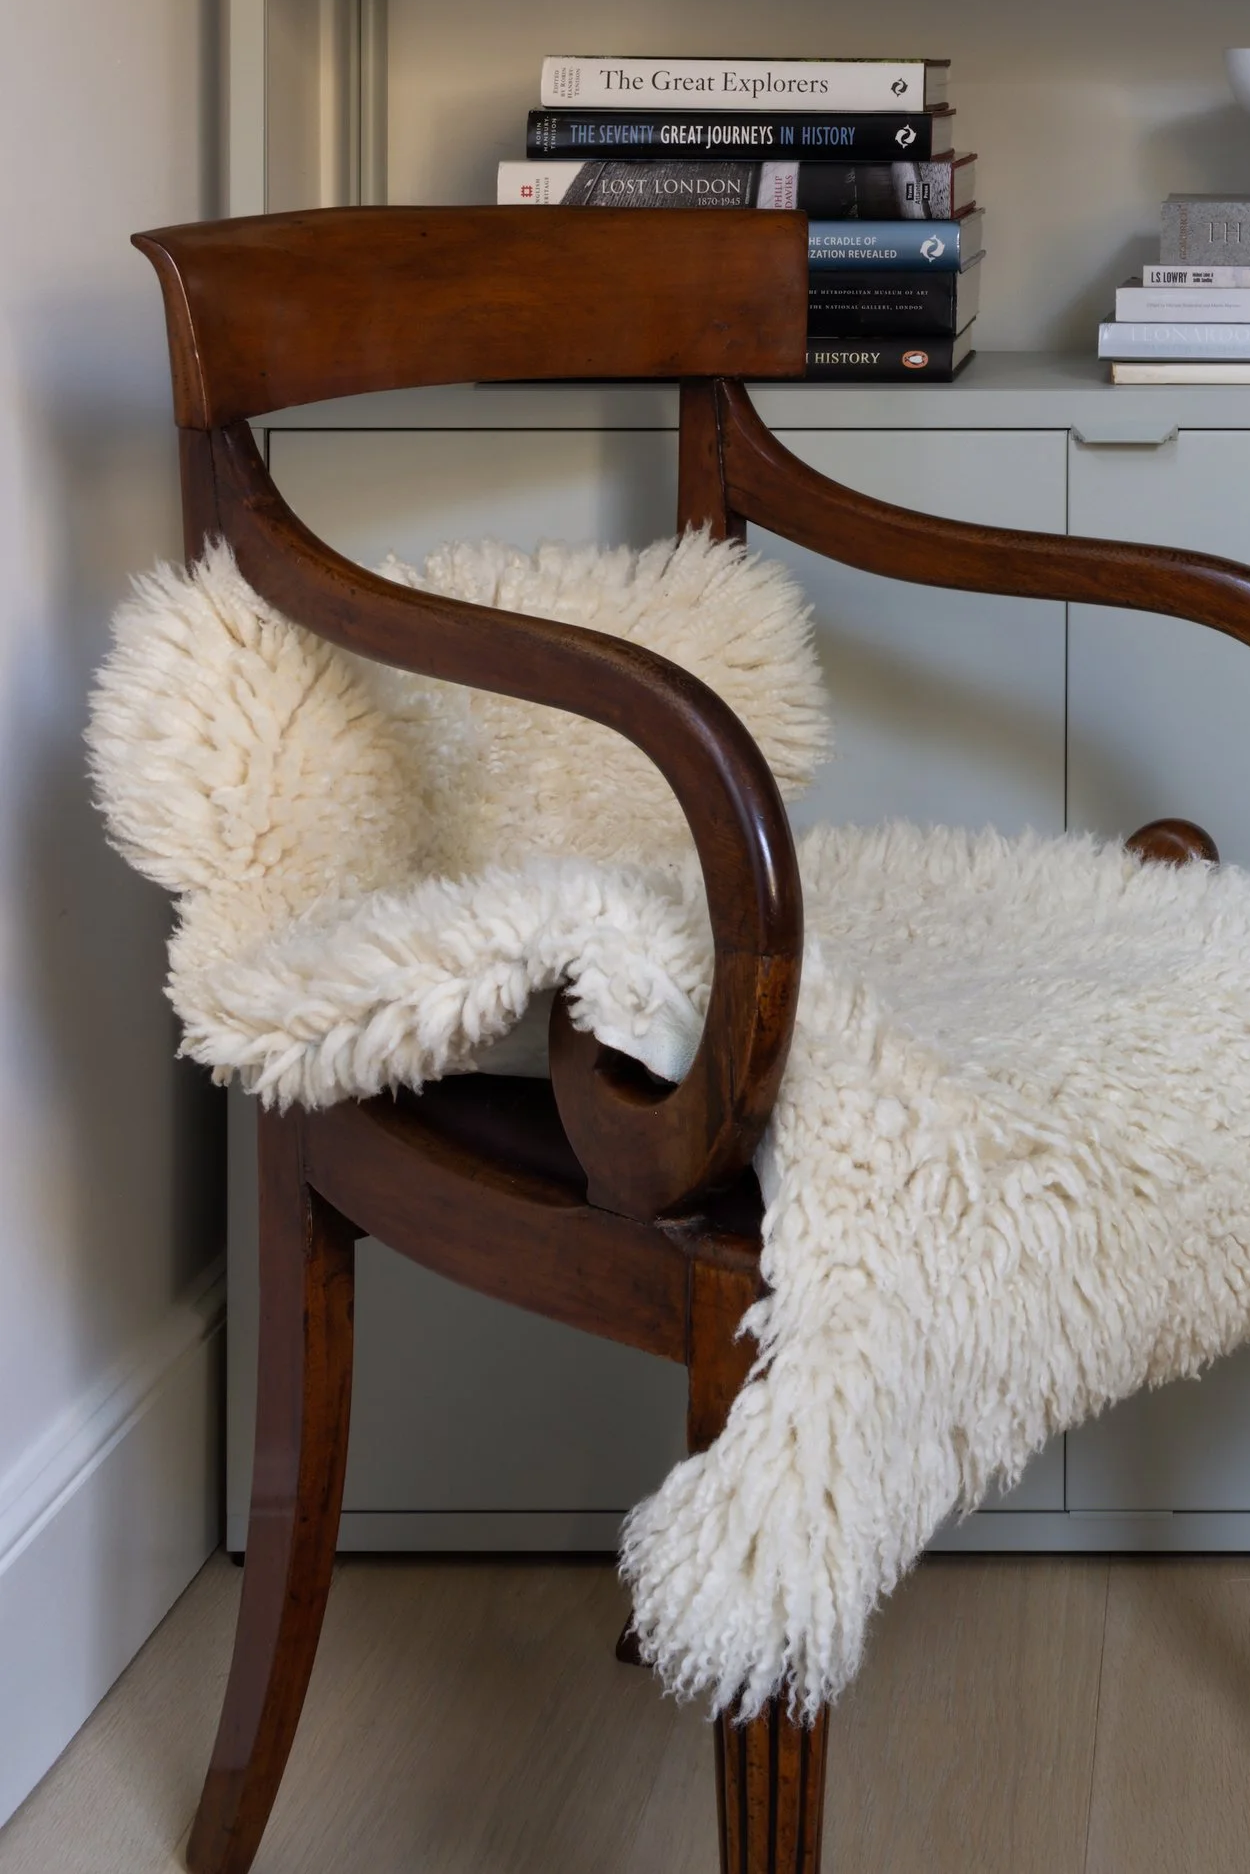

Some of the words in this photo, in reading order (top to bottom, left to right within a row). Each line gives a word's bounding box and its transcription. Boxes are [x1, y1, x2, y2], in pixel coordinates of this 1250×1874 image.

[600, 69, 644, 90] The
[651, 70, 715, 92] Great
[721, 71, 829, 99] Explorers
[570, 125, 595, 144] THE
[599, 125, 654, 144] SEVENTY
[660, 125, 704, 145] GREAT
[706, 125, 774, 149] JOURNEYS
[780, 126, 794, 145] IN
[801, 126, 855, 147] HISTORY
[602, 179, 647, 194] LOST
[655, 178, 742, 195] LONDON
[698, 197, 741, 206] 1870-1945
[824, 237, 861, 246] CRADLE
[864, 237, 877, 245] OF
[848, 250, 897, 259] REVEALED
[1163, 272, 1188, 283] LOWRY
[815, 352, 881, 364] HISTORY
